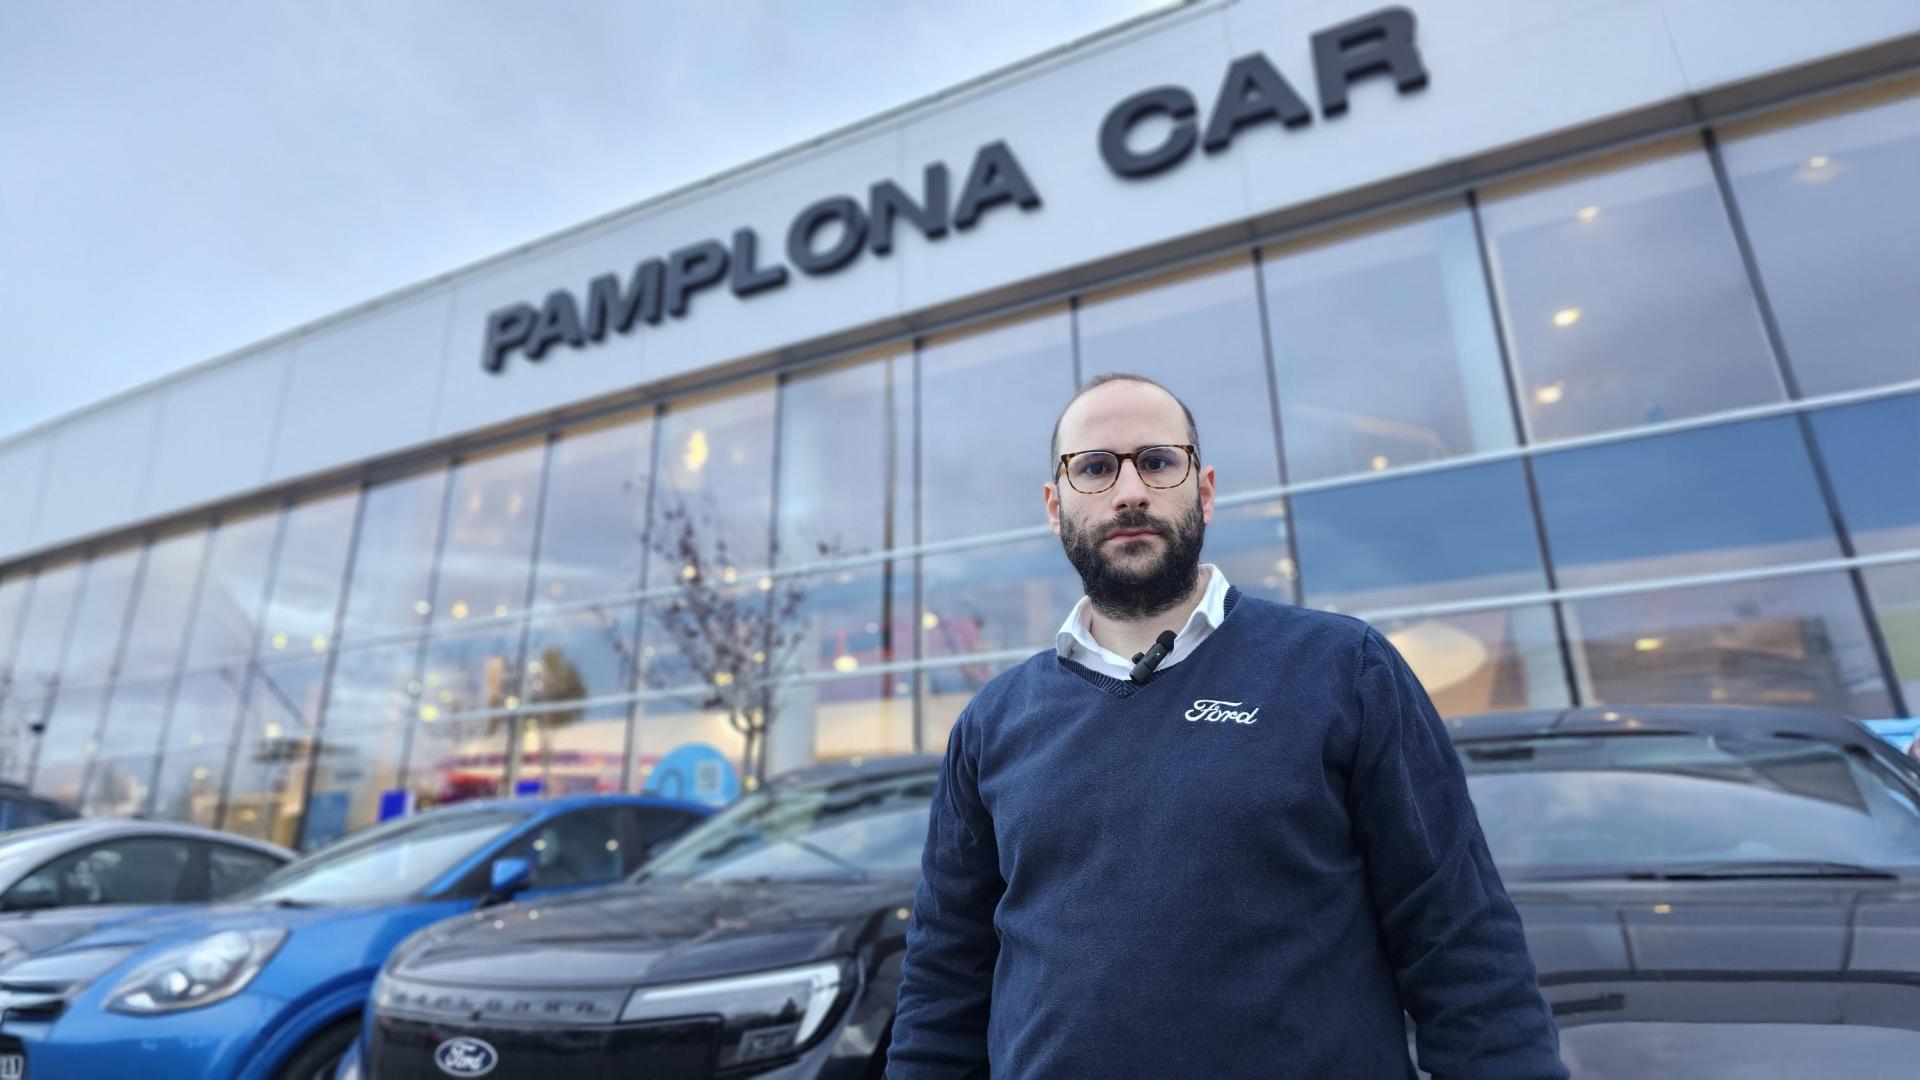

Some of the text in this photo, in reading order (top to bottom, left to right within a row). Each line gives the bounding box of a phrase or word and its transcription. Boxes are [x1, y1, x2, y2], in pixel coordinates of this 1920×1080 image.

[483, 5, 1430, 374] PAMPLONA CAR
[1184, 699, 1260, 725] Ford
[443, 1041, 487, 1071] Ford
